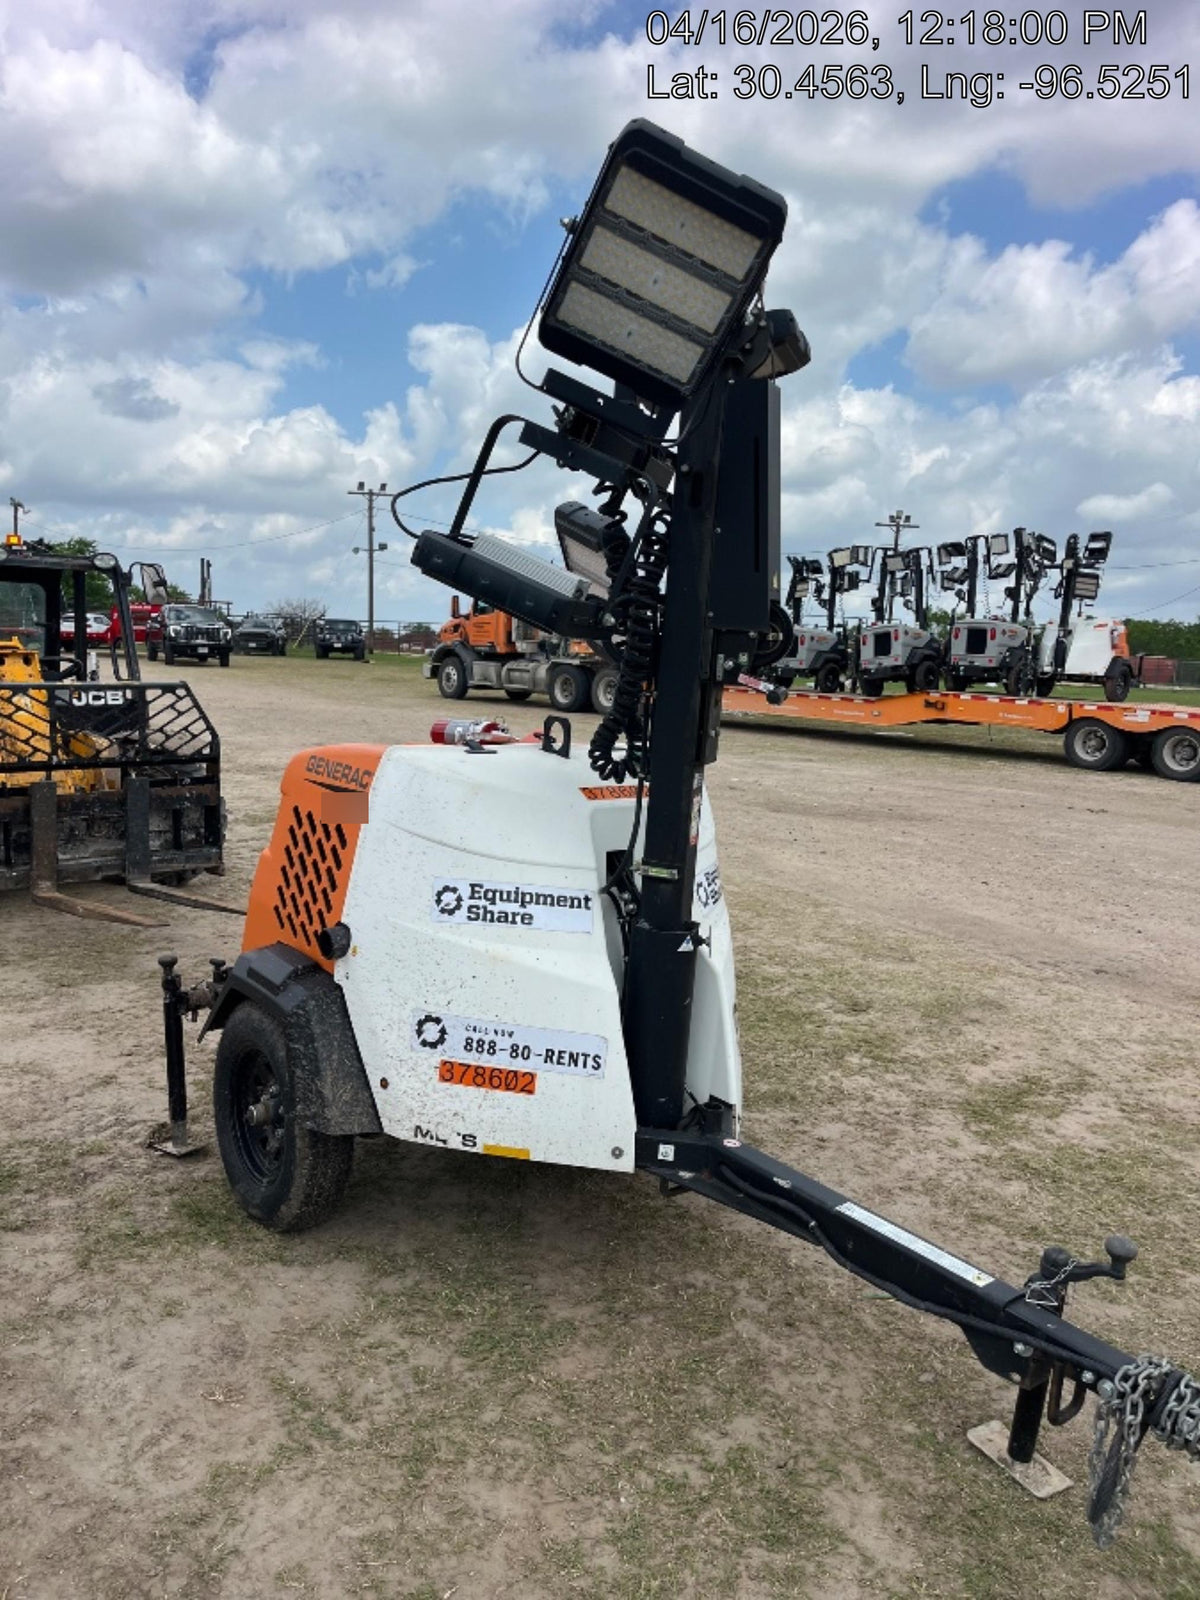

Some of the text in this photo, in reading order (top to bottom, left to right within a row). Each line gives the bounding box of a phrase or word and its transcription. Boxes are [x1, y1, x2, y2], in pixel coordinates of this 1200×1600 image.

[72, 690, 124, 707] JCB
[306, 755, 373, 790] GENERAC
[468, 883, 592, 911] Equipment
[467, 904, 534, 926] Share
[465, 1023, 515, 1038] CALL NOW
[464, 1036, 602, 1071] 888-80-RENTS
[440, 1061, 535, 1094] 378602
